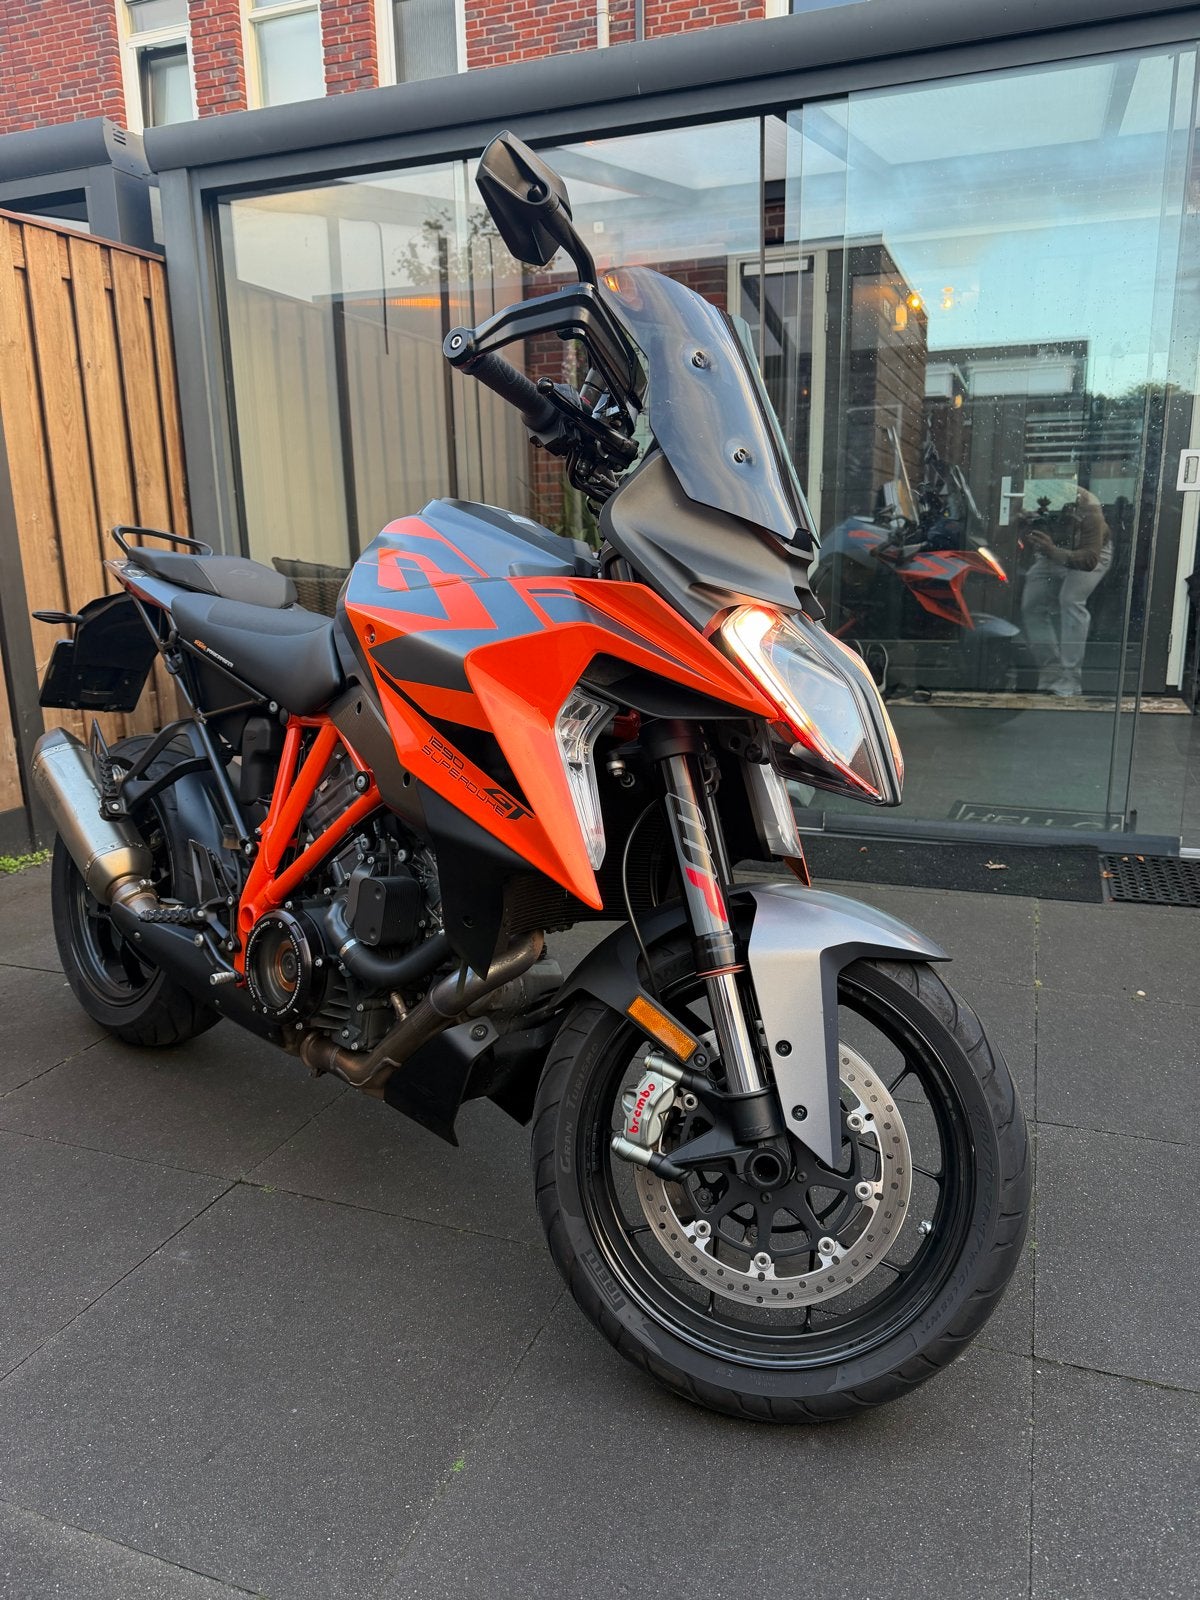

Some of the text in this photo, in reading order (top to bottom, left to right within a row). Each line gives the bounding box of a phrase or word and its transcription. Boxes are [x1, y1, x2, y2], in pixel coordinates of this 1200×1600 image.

[429, 735, 464, 770] 1290
[482, 788, 534, 820] GT
[628, 1083, 656, 1134] brembo
[560, 1121, 573, 1174] GRAN
[579, 1247, 627, 1313] PIRELLI
